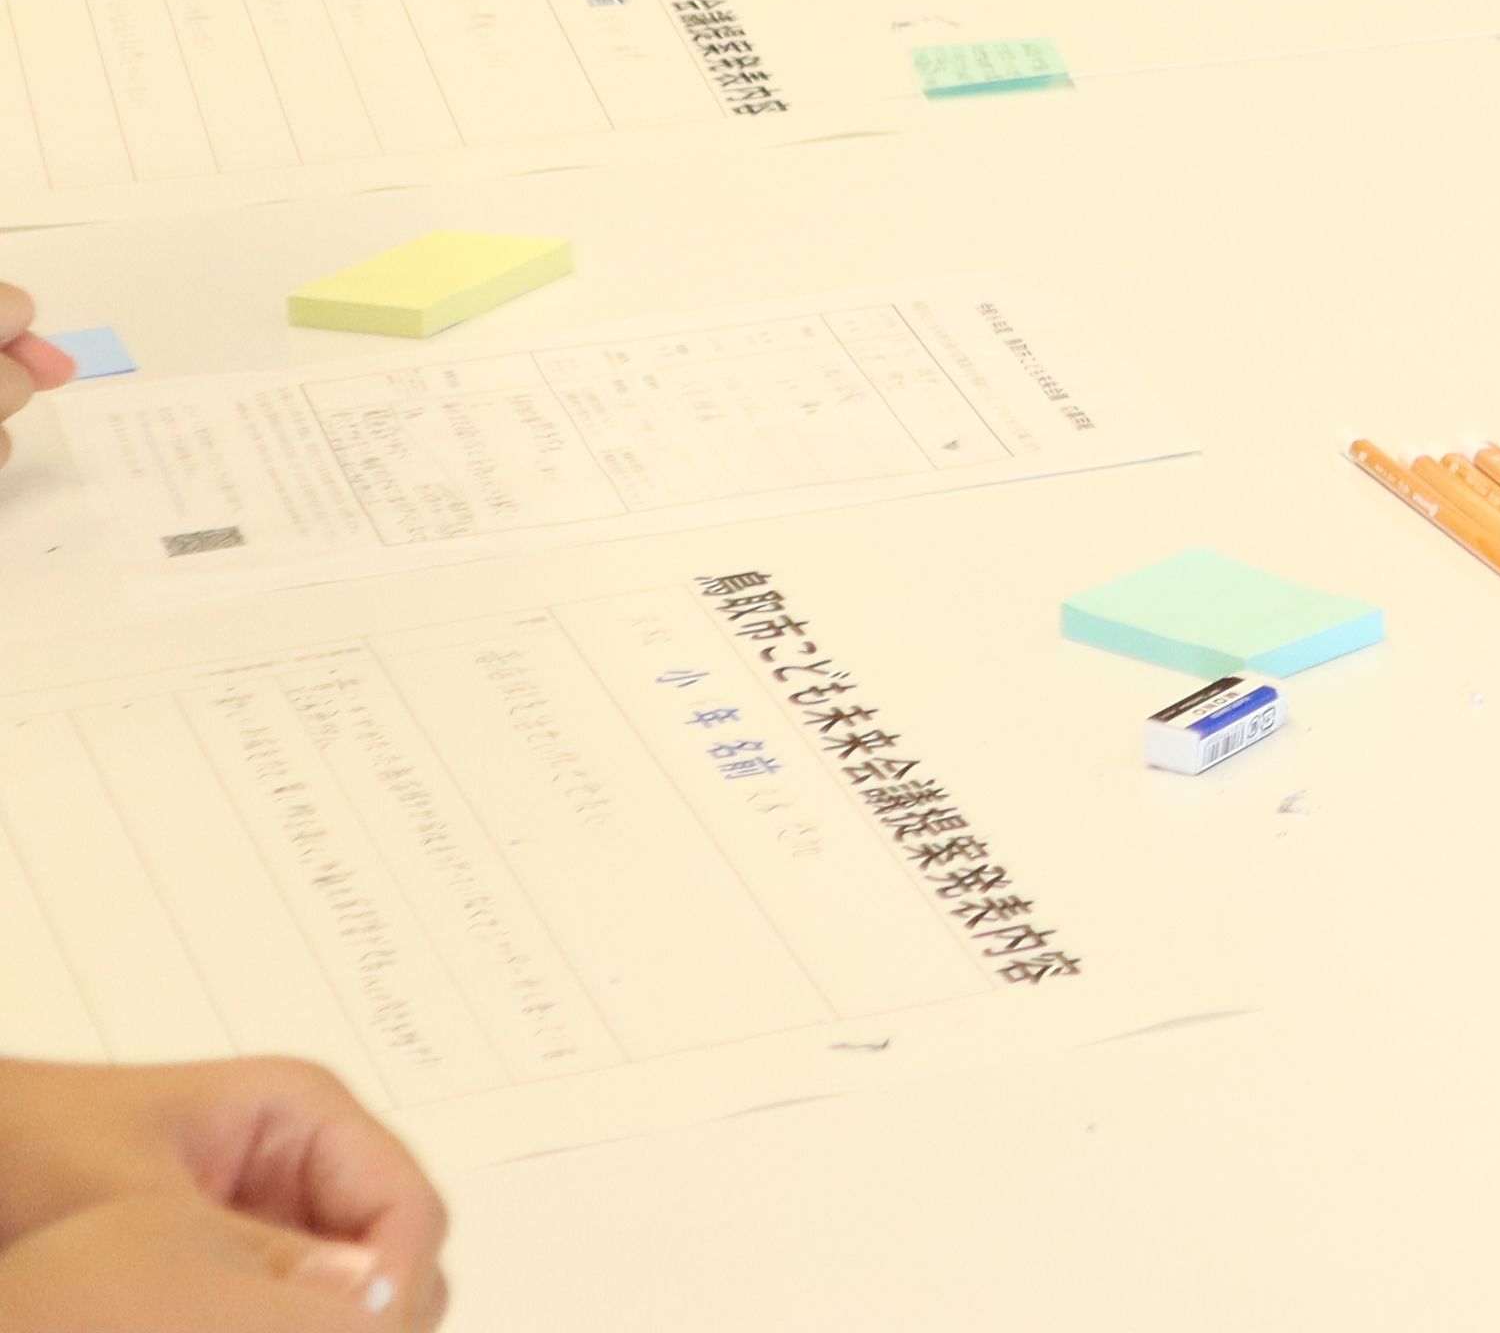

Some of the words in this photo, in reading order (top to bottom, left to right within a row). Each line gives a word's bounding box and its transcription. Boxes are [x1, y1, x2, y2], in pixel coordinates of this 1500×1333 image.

[693, 569, 1081, 988] 鳥取市こども未来会議提案発表内容
[704, 732, 781, 781] 名前
